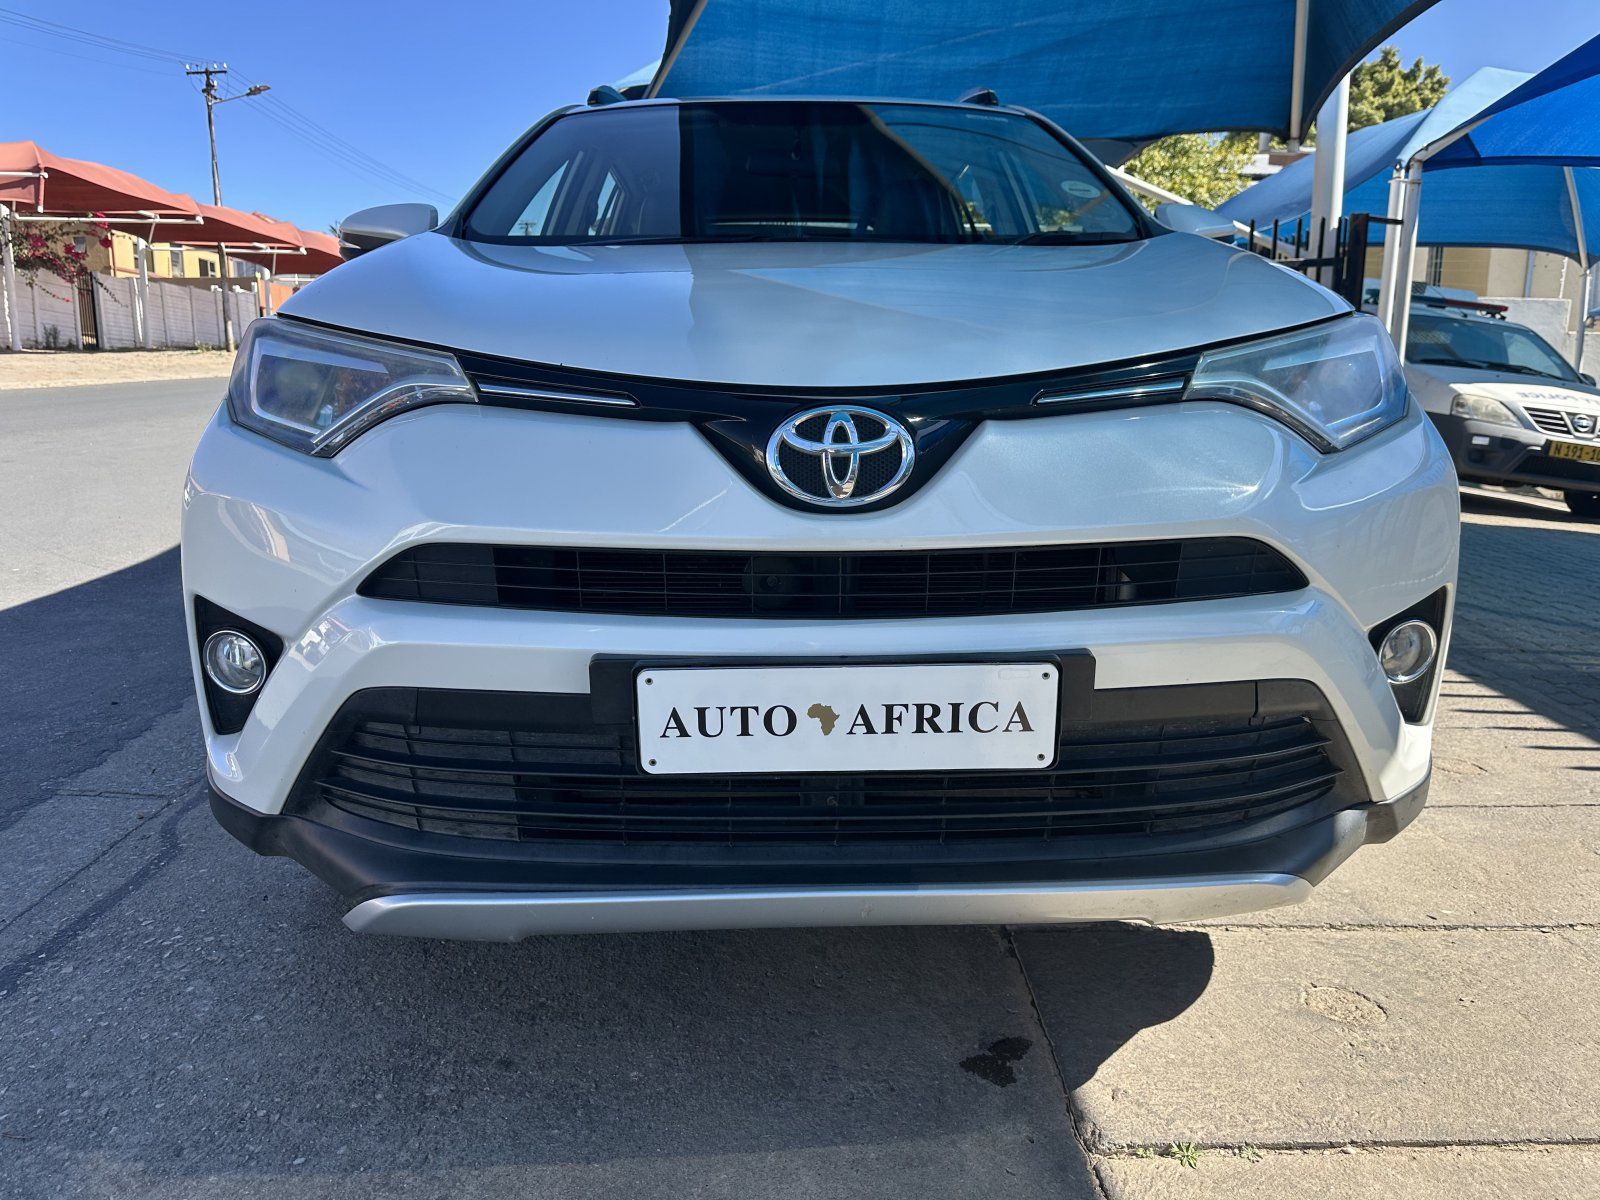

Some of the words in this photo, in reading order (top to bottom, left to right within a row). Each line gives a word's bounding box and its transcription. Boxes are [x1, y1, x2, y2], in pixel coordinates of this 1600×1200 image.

[1554, 443, 1563, 456] N
[659, 704, 798, 739] AUTO
[846, 700, 1035, 735] AFRICA
